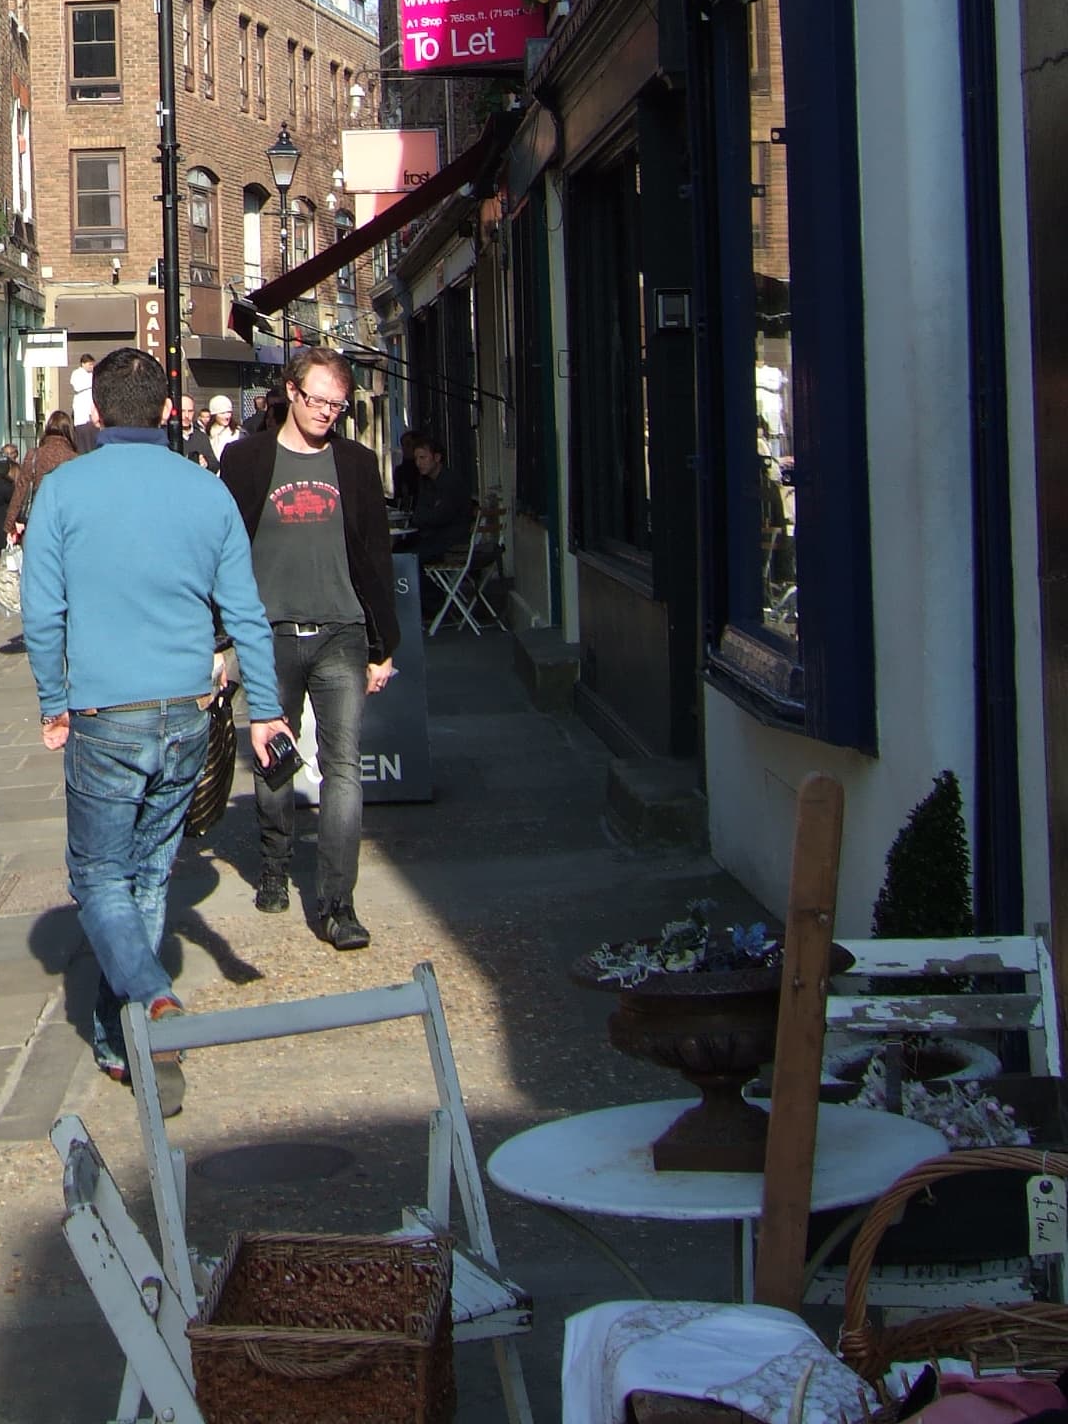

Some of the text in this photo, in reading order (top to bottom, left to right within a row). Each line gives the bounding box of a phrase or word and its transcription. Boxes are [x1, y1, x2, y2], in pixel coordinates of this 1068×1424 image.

[420, 17, 443, 29] Shop
[406, 26, 497, 61] To Let
[359, 754, 402, 781] EN
